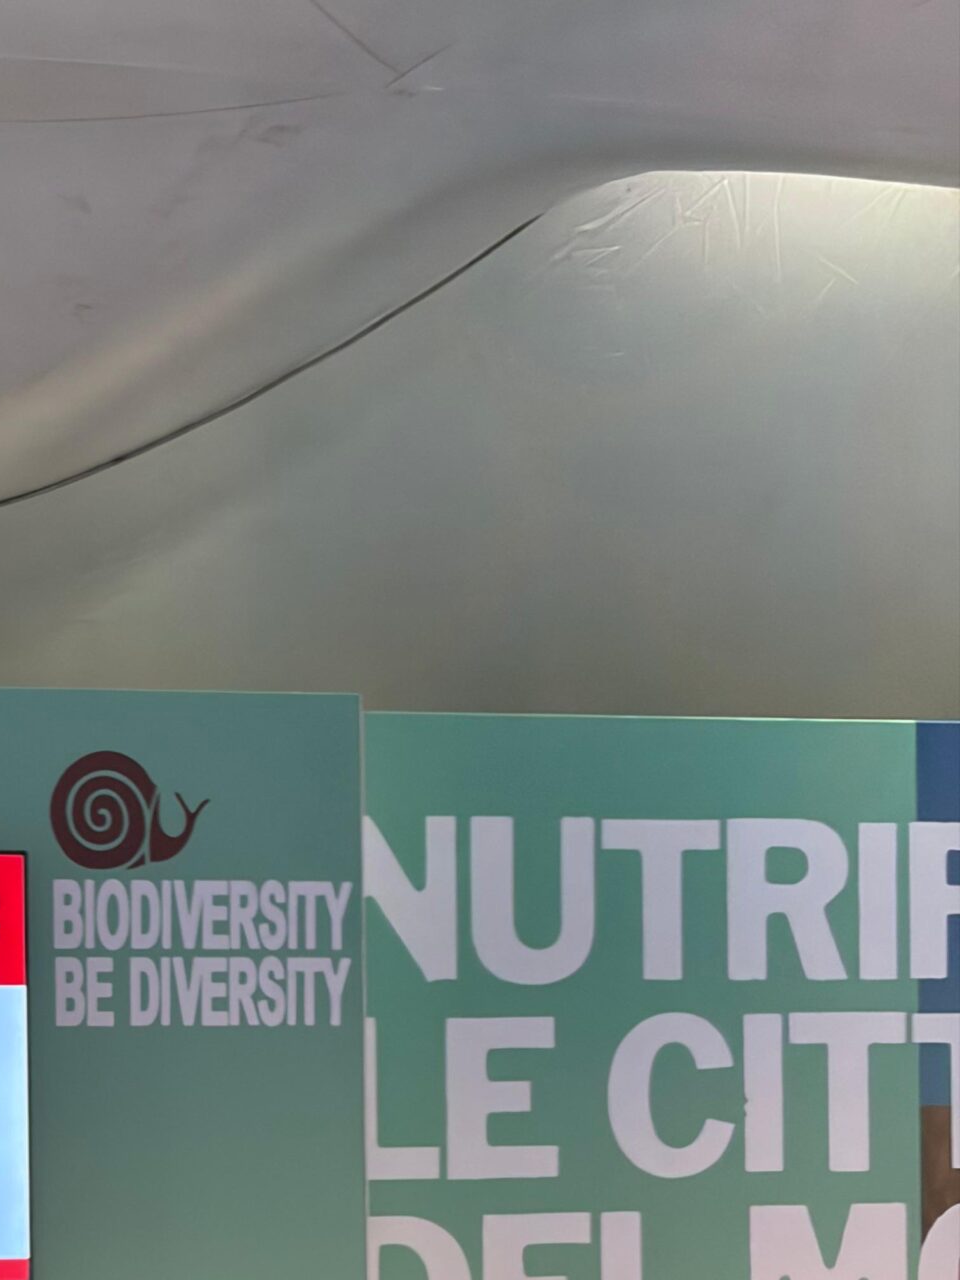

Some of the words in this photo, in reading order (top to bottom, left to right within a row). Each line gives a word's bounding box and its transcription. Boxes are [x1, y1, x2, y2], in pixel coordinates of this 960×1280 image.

[52, 879, 353, 951] BIODIVERSITY
[55, 957, 115, 1027] BE
[130, 957, 353, 1027] DIVERSITY
[365, 1017, 559, 1180] LE
